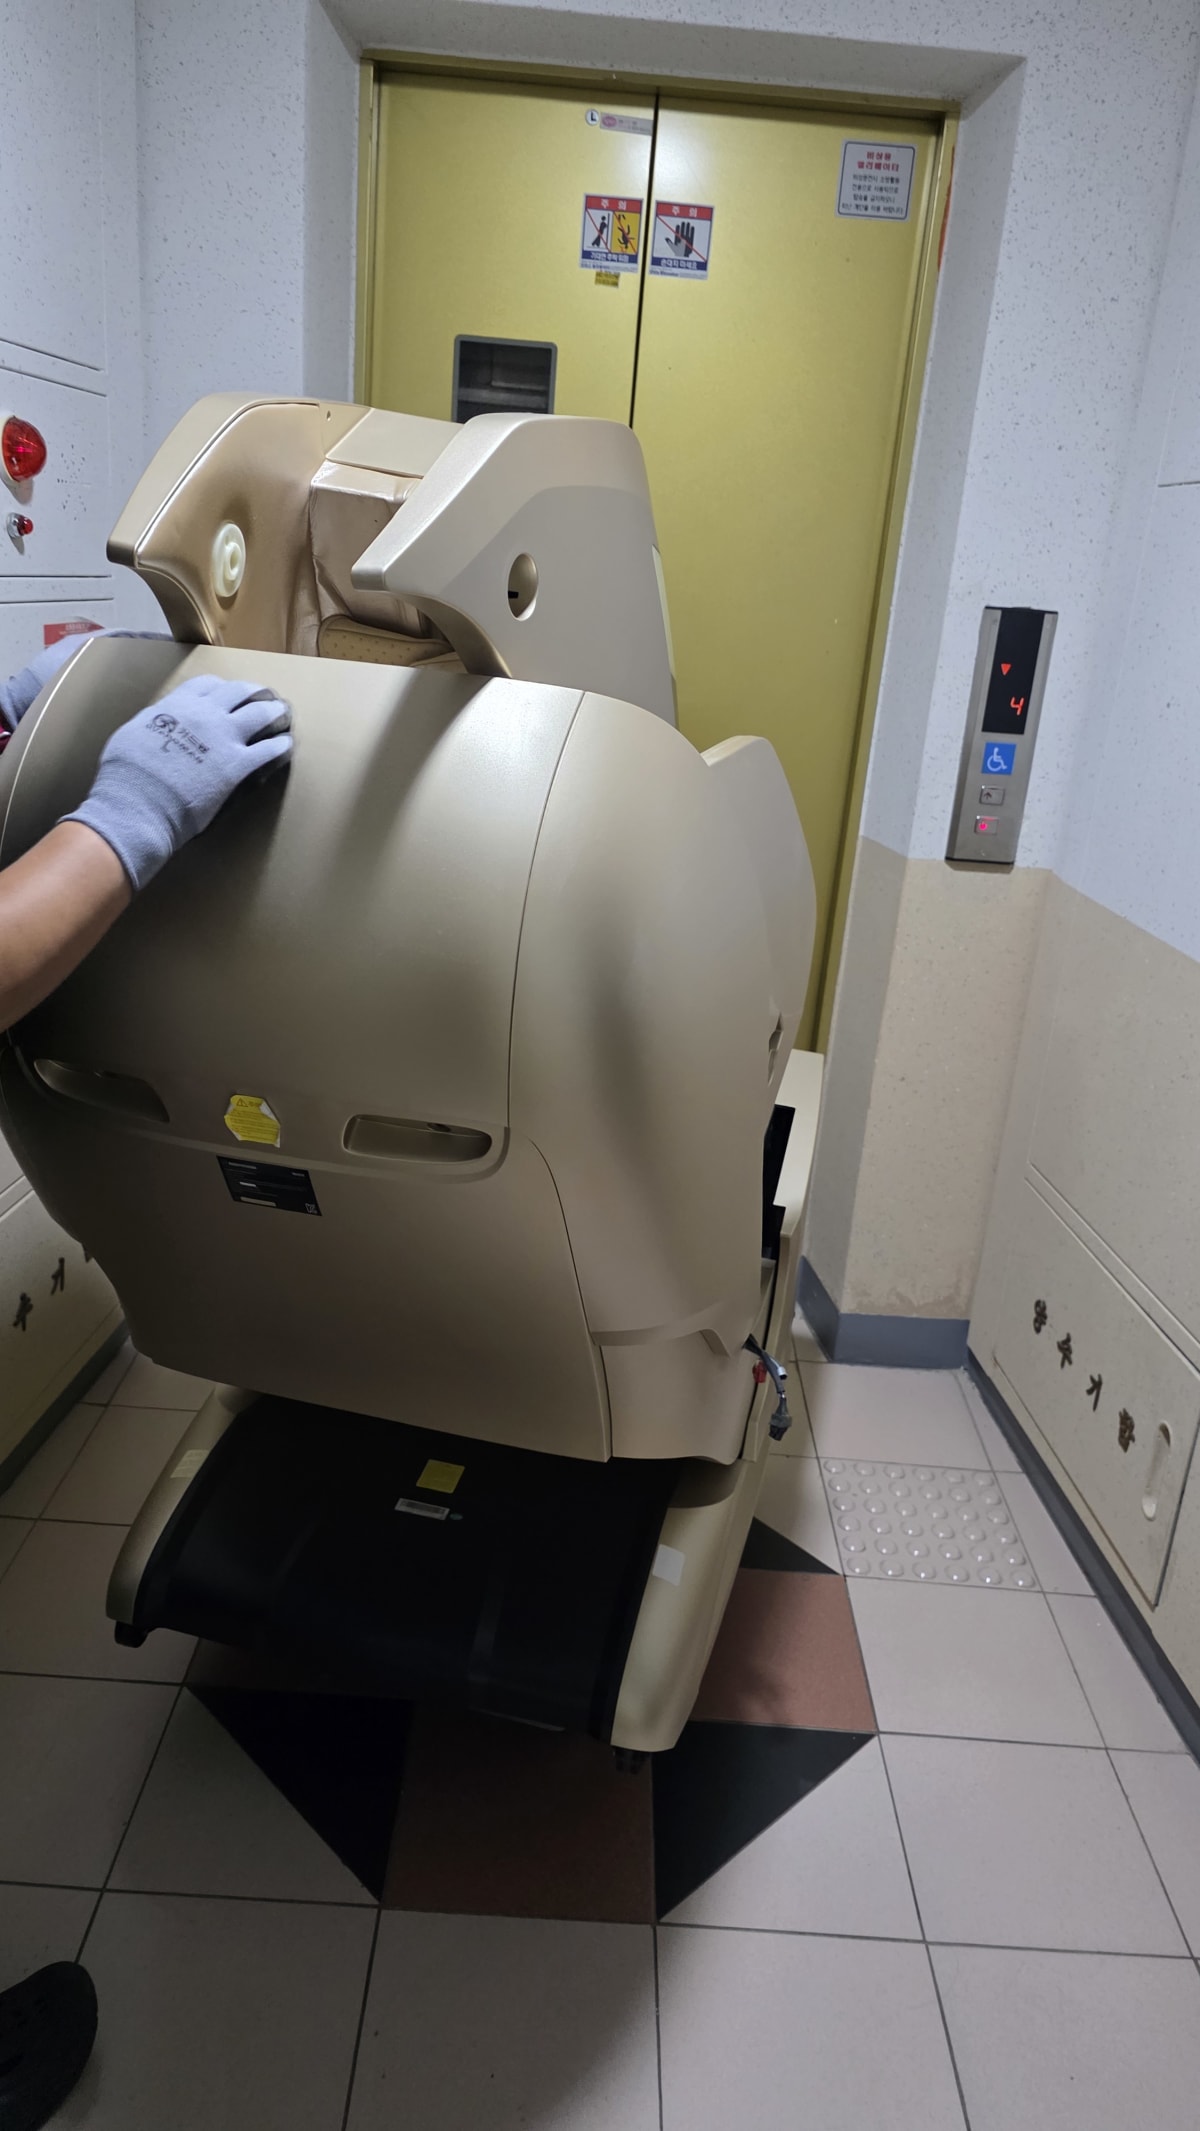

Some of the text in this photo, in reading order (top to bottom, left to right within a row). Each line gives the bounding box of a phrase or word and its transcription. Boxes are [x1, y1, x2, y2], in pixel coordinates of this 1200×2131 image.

[866, 151, 892, 161] 비상용
[857, 161, 900, 172] 엘리베이터
[1010, 697, 1025, 716] 4
